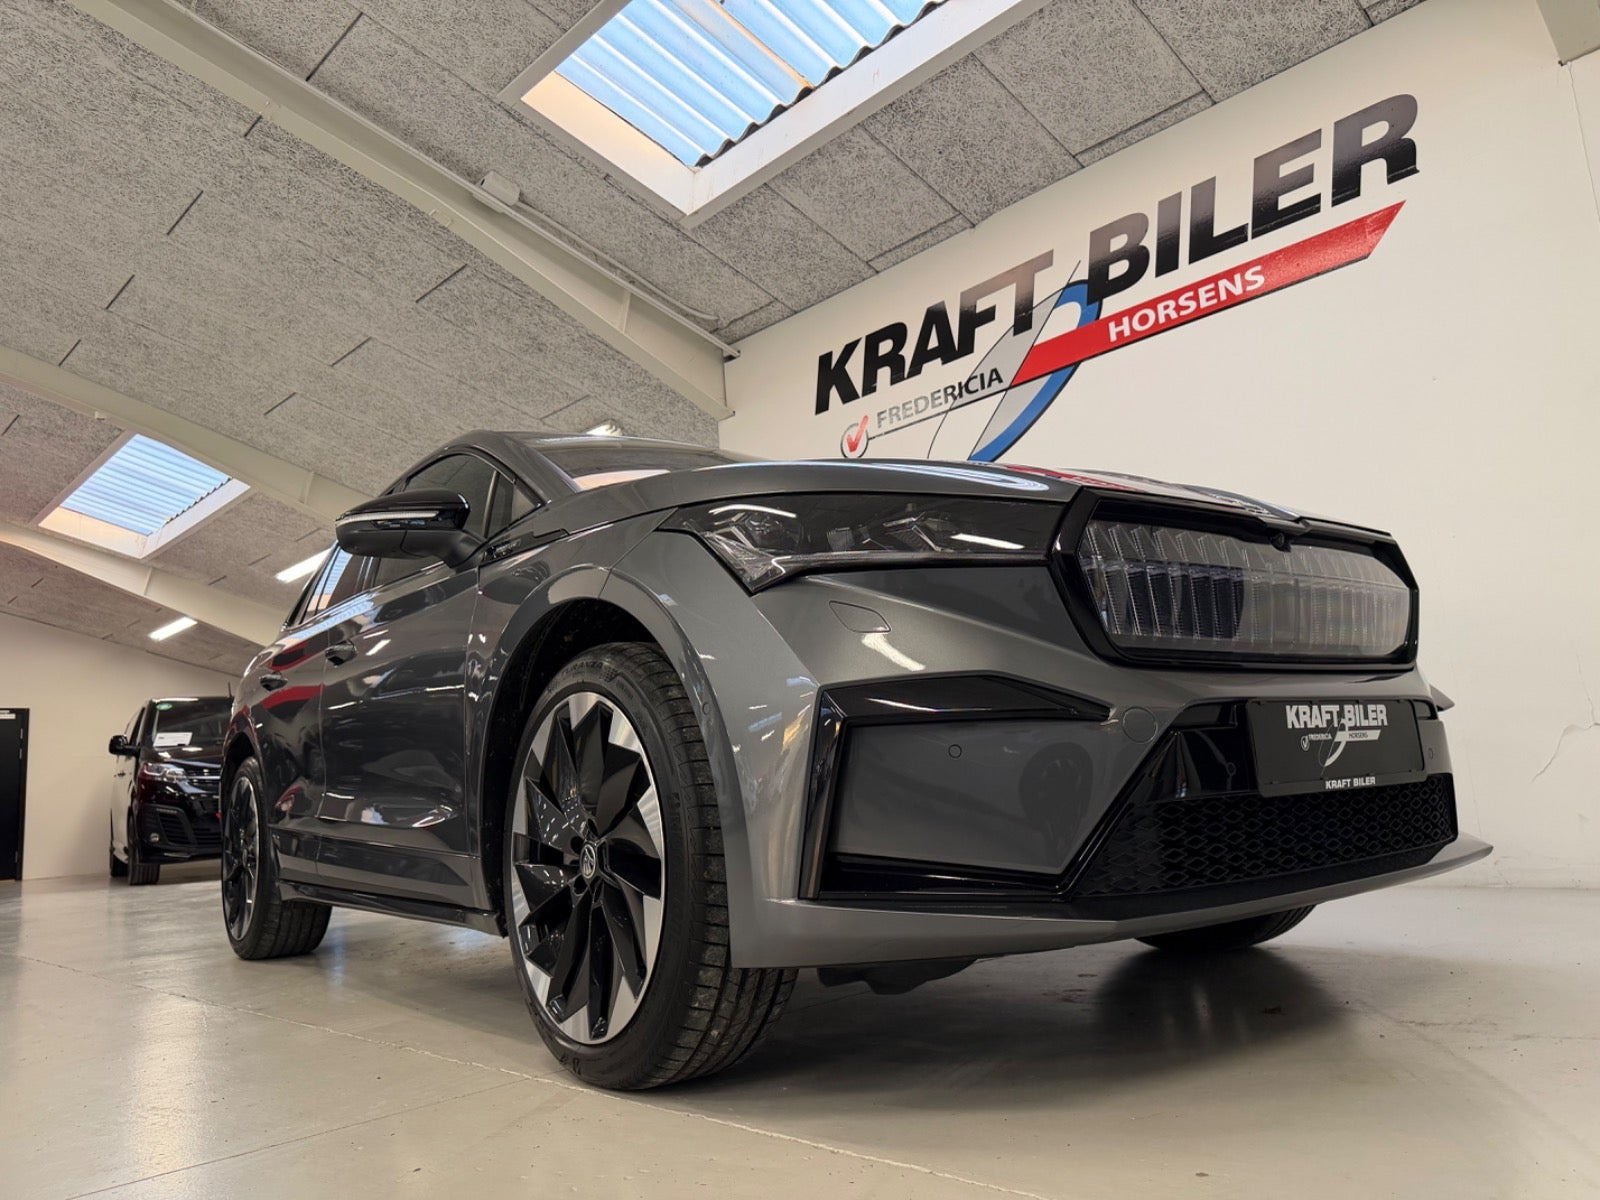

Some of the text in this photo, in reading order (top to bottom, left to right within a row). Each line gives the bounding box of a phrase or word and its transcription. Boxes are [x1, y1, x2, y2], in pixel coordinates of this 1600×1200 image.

[815, 93, 1420, 415] KRAFT BILER
[1108, 265, 1266, 342] HORSENS
[876, 367, 1004, 429] FREDERICIA
[1285, 704, 1388, 729] KRAFT BILER
[1325, 776, 1376, 790] KRAFT BILER
